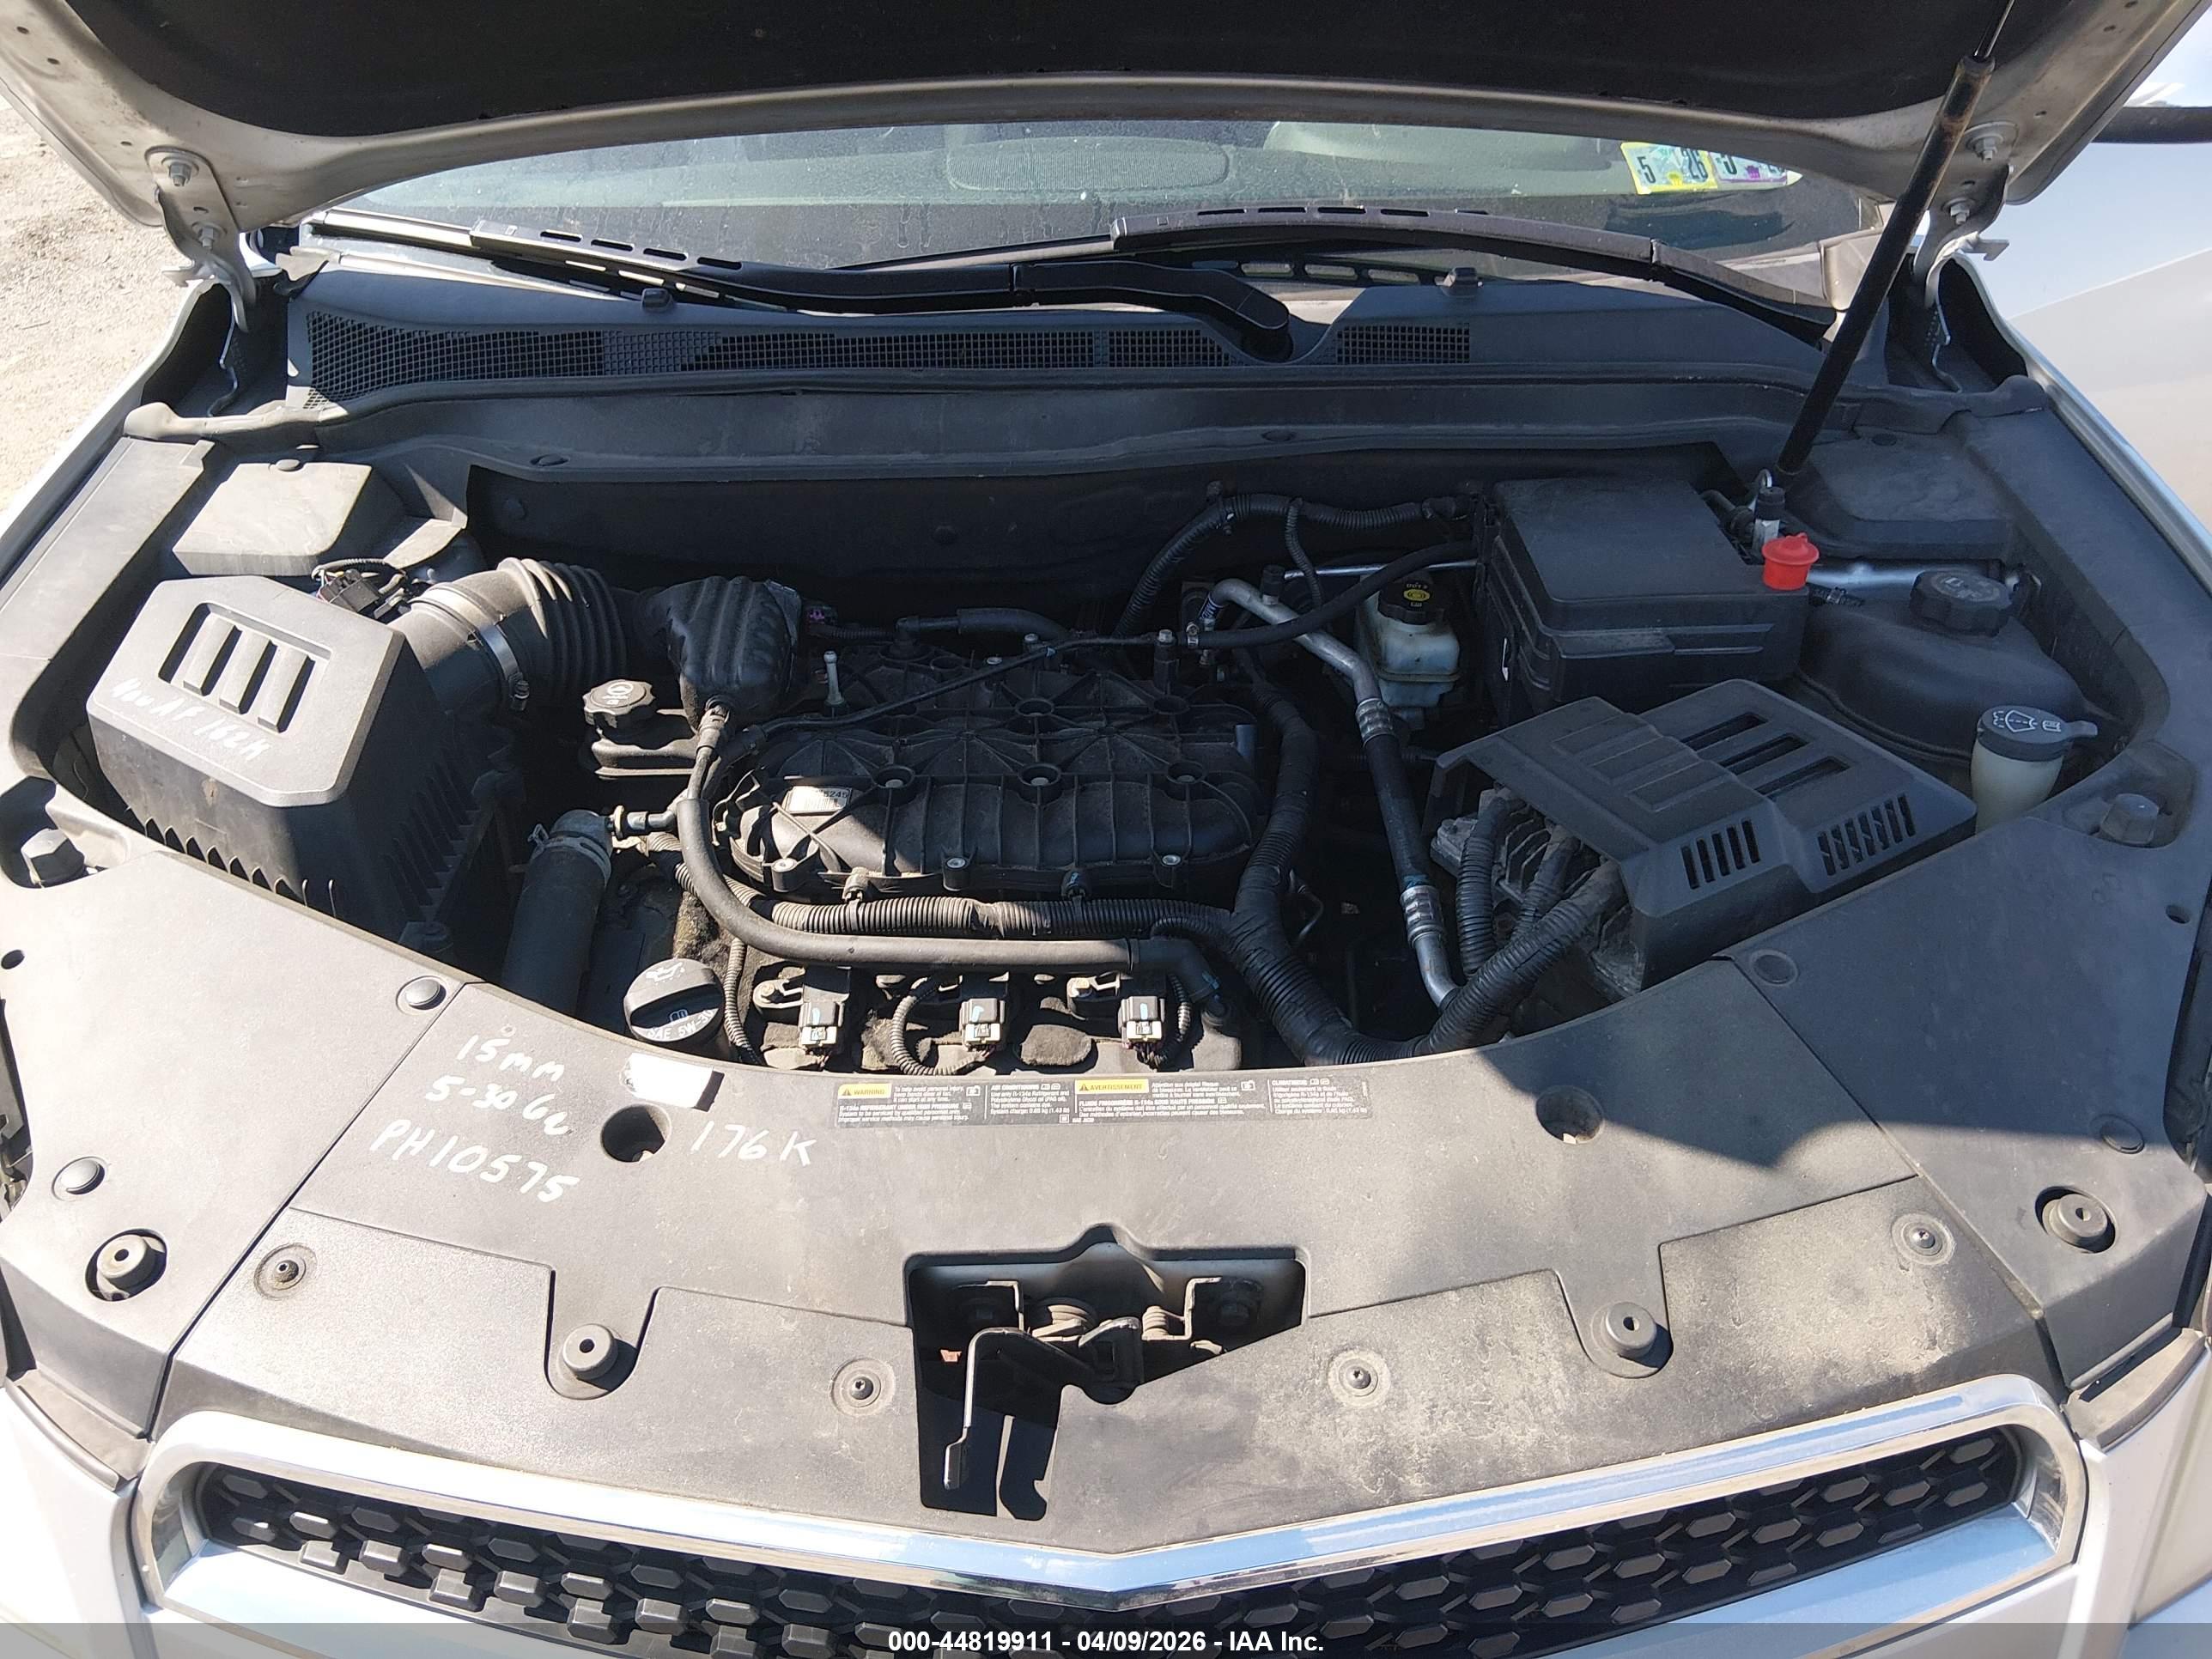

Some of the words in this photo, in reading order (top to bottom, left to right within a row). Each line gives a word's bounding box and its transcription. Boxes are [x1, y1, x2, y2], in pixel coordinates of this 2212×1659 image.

[1637, 156, 1656, 184] 5
[648, 1028, 671, 1039] SAE
[369, 1119, 580, 1203] PH10575
